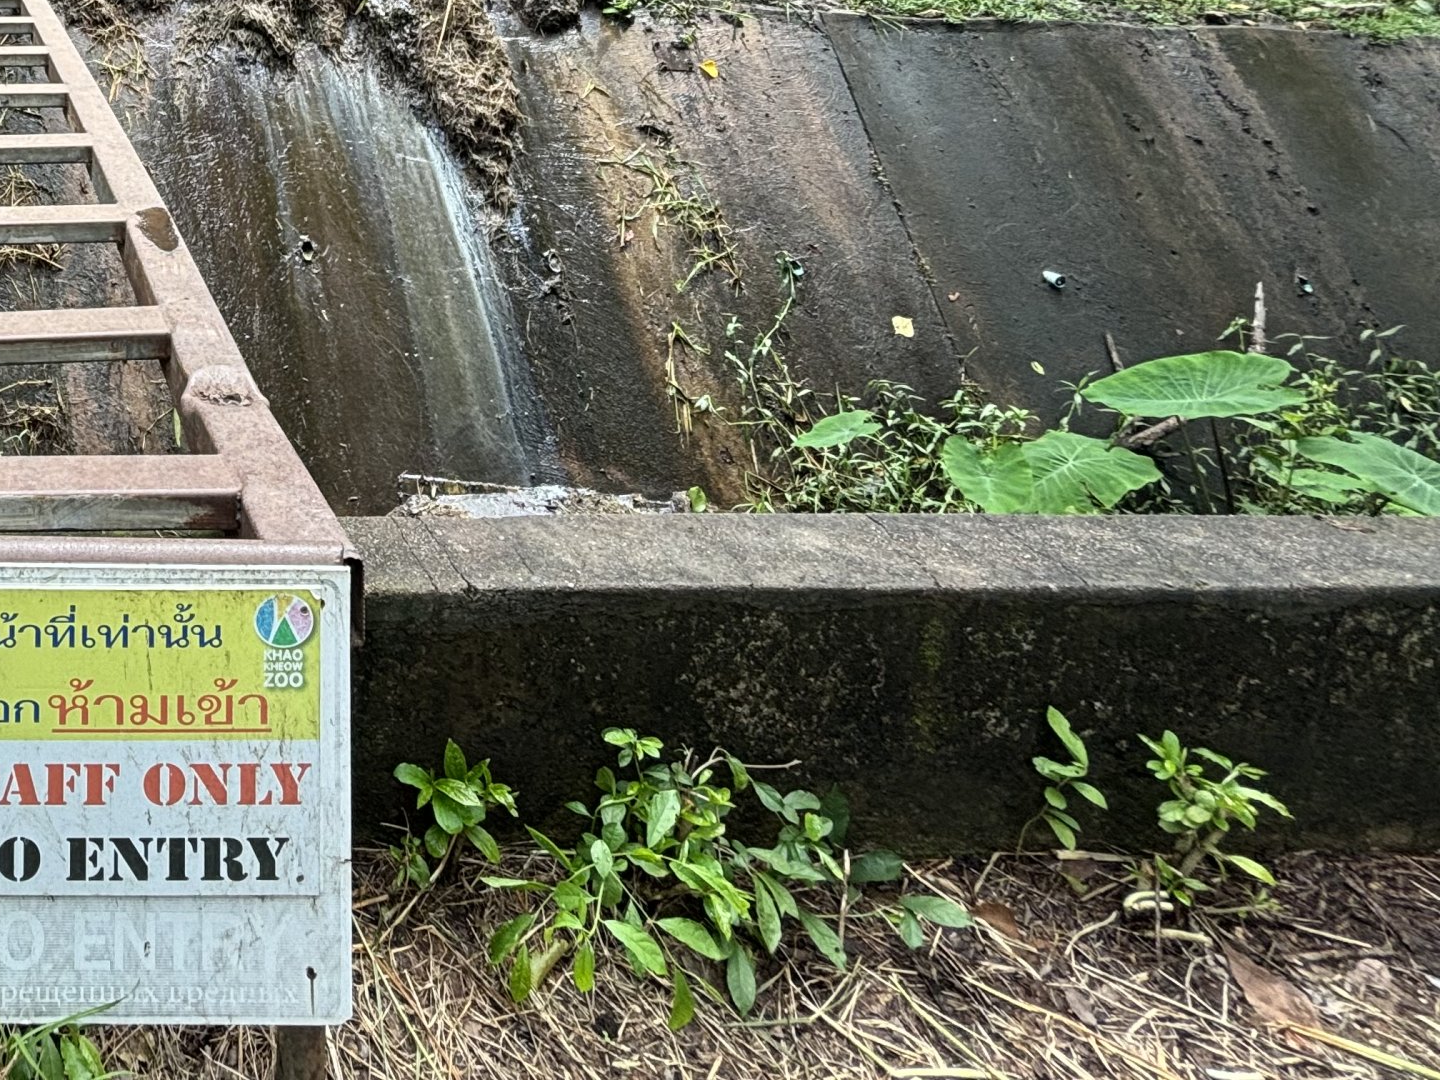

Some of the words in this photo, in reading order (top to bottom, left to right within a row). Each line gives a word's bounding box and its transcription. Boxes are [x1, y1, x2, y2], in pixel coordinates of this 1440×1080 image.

[264, 649, 303, 661] KHAO
[264, 662, 303, 671] KHEOW
[264, 672, 304, 688] ZOO
[143, 763, 311, 805] ONLY
[66, 837, 290, 880] ENTRY
[74, 911, 293, 971] ENTRY
